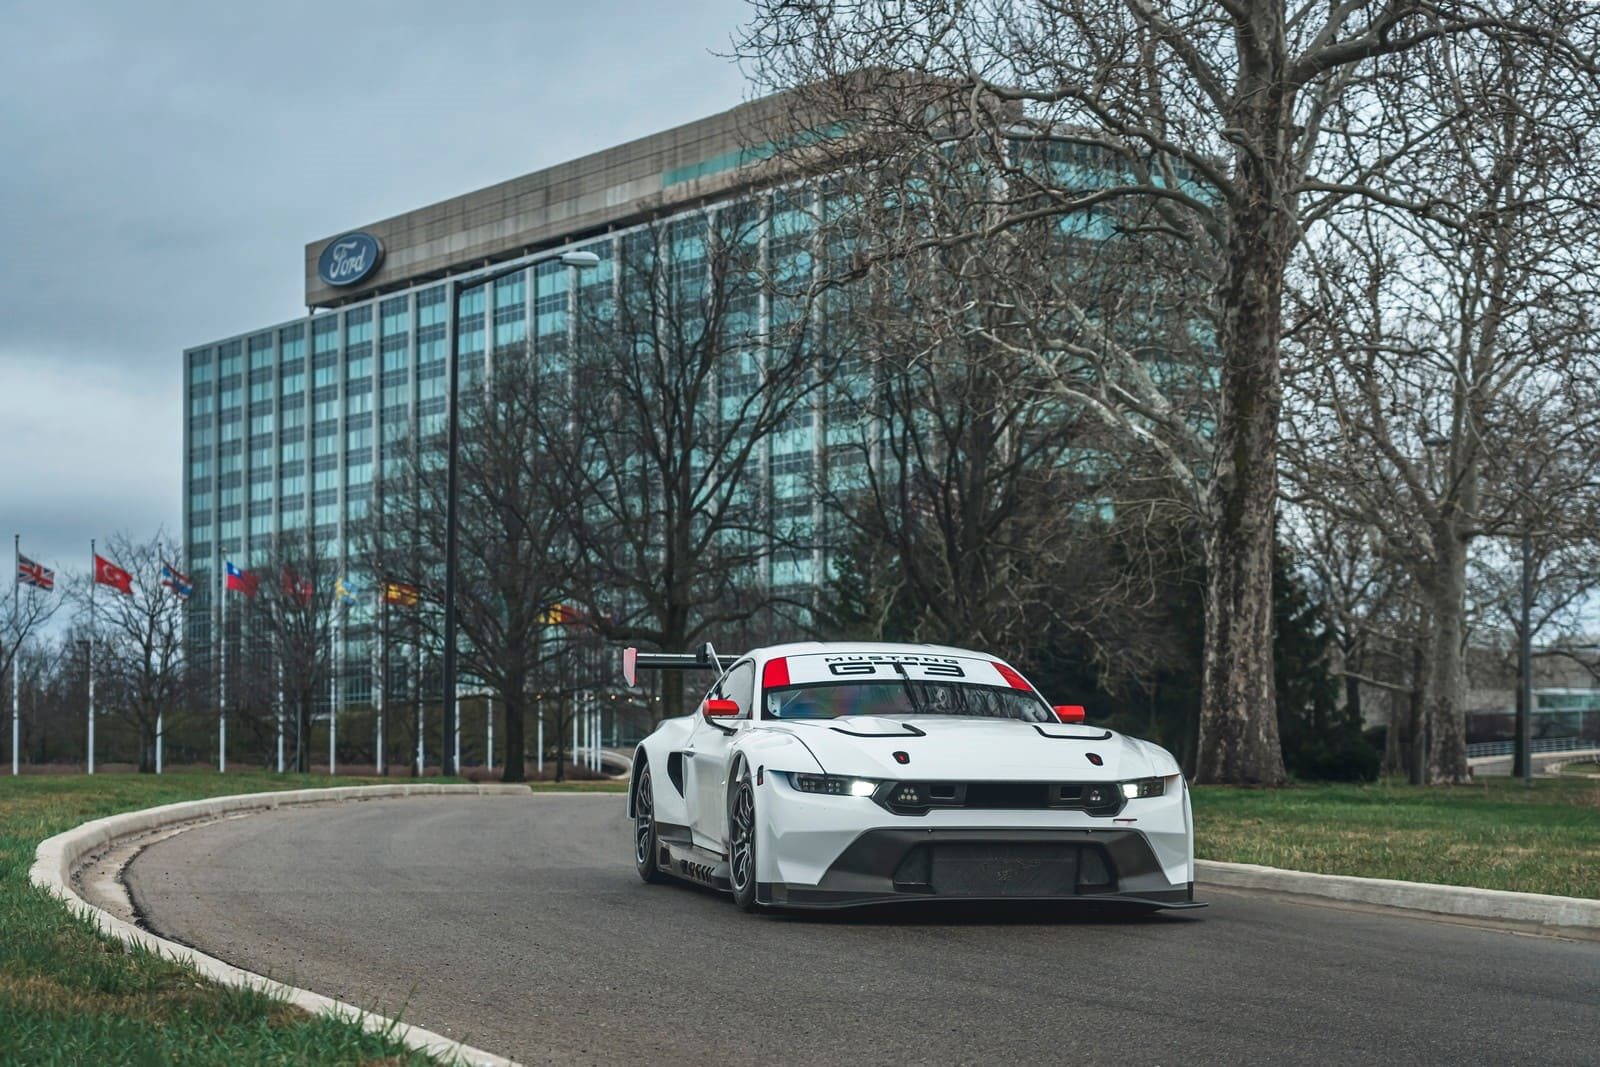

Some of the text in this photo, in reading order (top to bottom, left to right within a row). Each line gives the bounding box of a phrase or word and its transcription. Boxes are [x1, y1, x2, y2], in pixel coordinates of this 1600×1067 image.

[329, 241, 366, 279] Ford
[824, 655, 960, 665] MUSTANG
[828, 661, 966, 678] GT3
